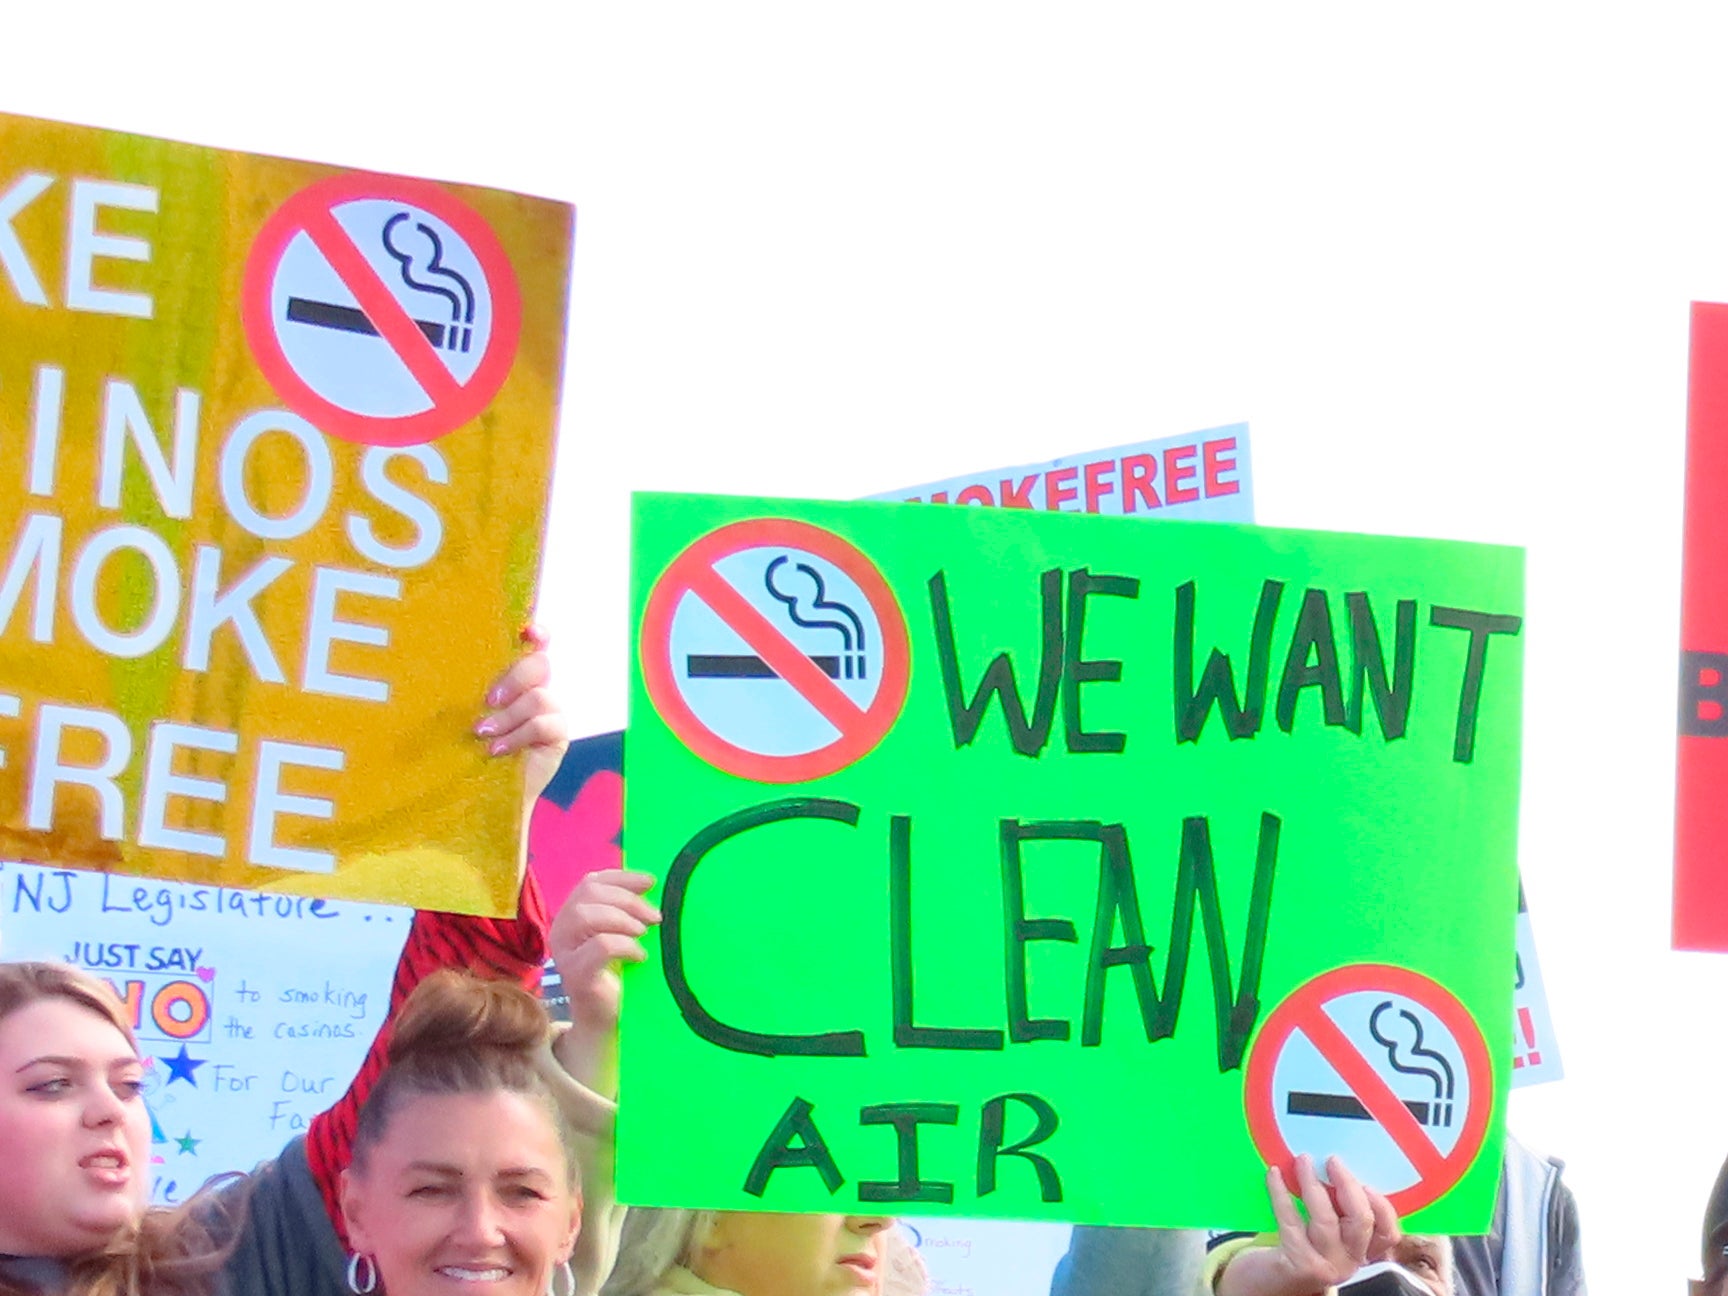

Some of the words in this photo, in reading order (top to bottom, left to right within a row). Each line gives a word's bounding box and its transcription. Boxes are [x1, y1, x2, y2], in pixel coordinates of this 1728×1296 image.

[928, 568, 1139, 758] WE
[1174, 580, 1522, 765] WANT
[0, 694, 345, 874] REE
[13, 872, 78, 914] NJ
[145, 946, 203, 972] SAY
[661, 796, 1282, 1072] CLEAN
[235, 980, 261, 1004] to
[282, 980, 369, 1020] smoking
[213, 1064, 258, 1094] For
[743, 1093, 1063, 1203] AIR
